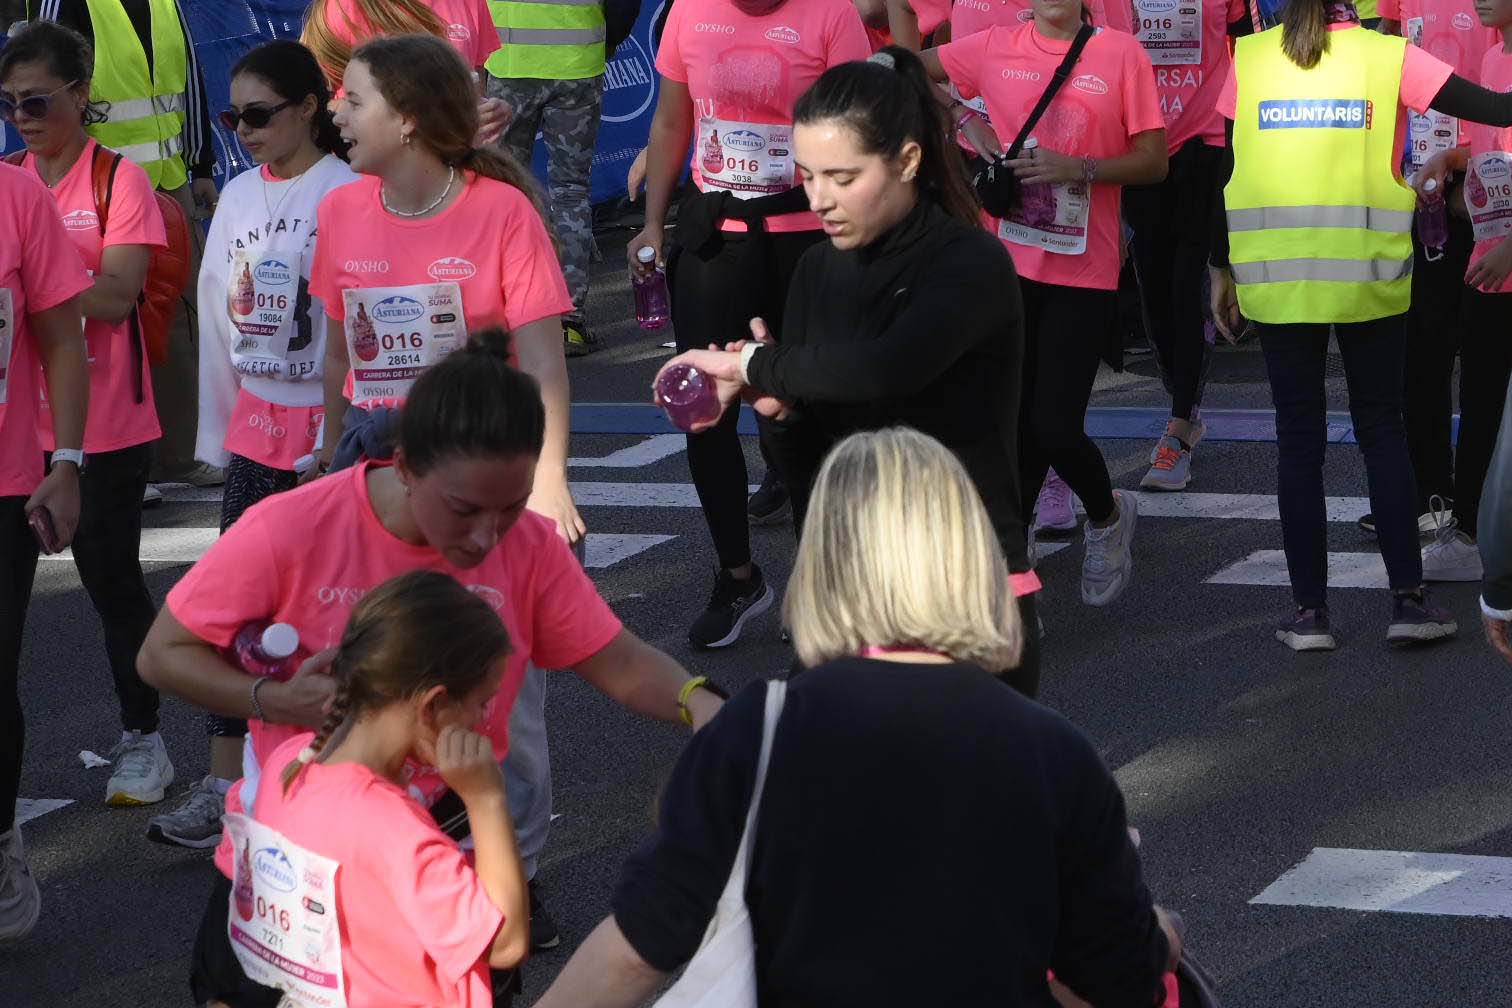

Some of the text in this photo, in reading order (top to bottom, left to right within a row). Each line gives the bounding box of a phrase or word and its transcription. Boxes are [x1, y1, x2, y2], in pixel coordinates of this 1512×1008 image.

[1141, 1, 1174, 9] ASTURIANA
[695, 23, 735, 34] OYSHO
[1143, 18, 1172, 29] 016
[767, 31, 798, 41] ASTURIANA
[1148, 32, 1167, 40] 2593
[1002, 69, 1041, 81] OYSHO
[1260, 105, 1363, 123] VOLUNTARIS
[726, 135, 762, 148] ASTURIANA
[726, 157, 759, 172] 016
[731, 174, 752, 183] 3038
[1487, 184, 1511, 199] 016
[1005, 226, 1029, 239] OYSHO
[1047, 238, 1080, 249] Santander
[345, 260, 389, 273] OYSHO
[432, 265, 472, 275] ASTURIANA
[257, 292, 287, 310] 016
[428, 299, 453, 307] SUMA
[259, 312, 283, 323] 19084
[376, 306, 421, 318] ASTURIANA
[381, 332, 423, 350] 016
[388, 354, 421, 366] 28614
[363, 371, 391, 379] CARRERA
[363, 387, 394, 397] OYSHO
[257, 896, 291, 932] 016
